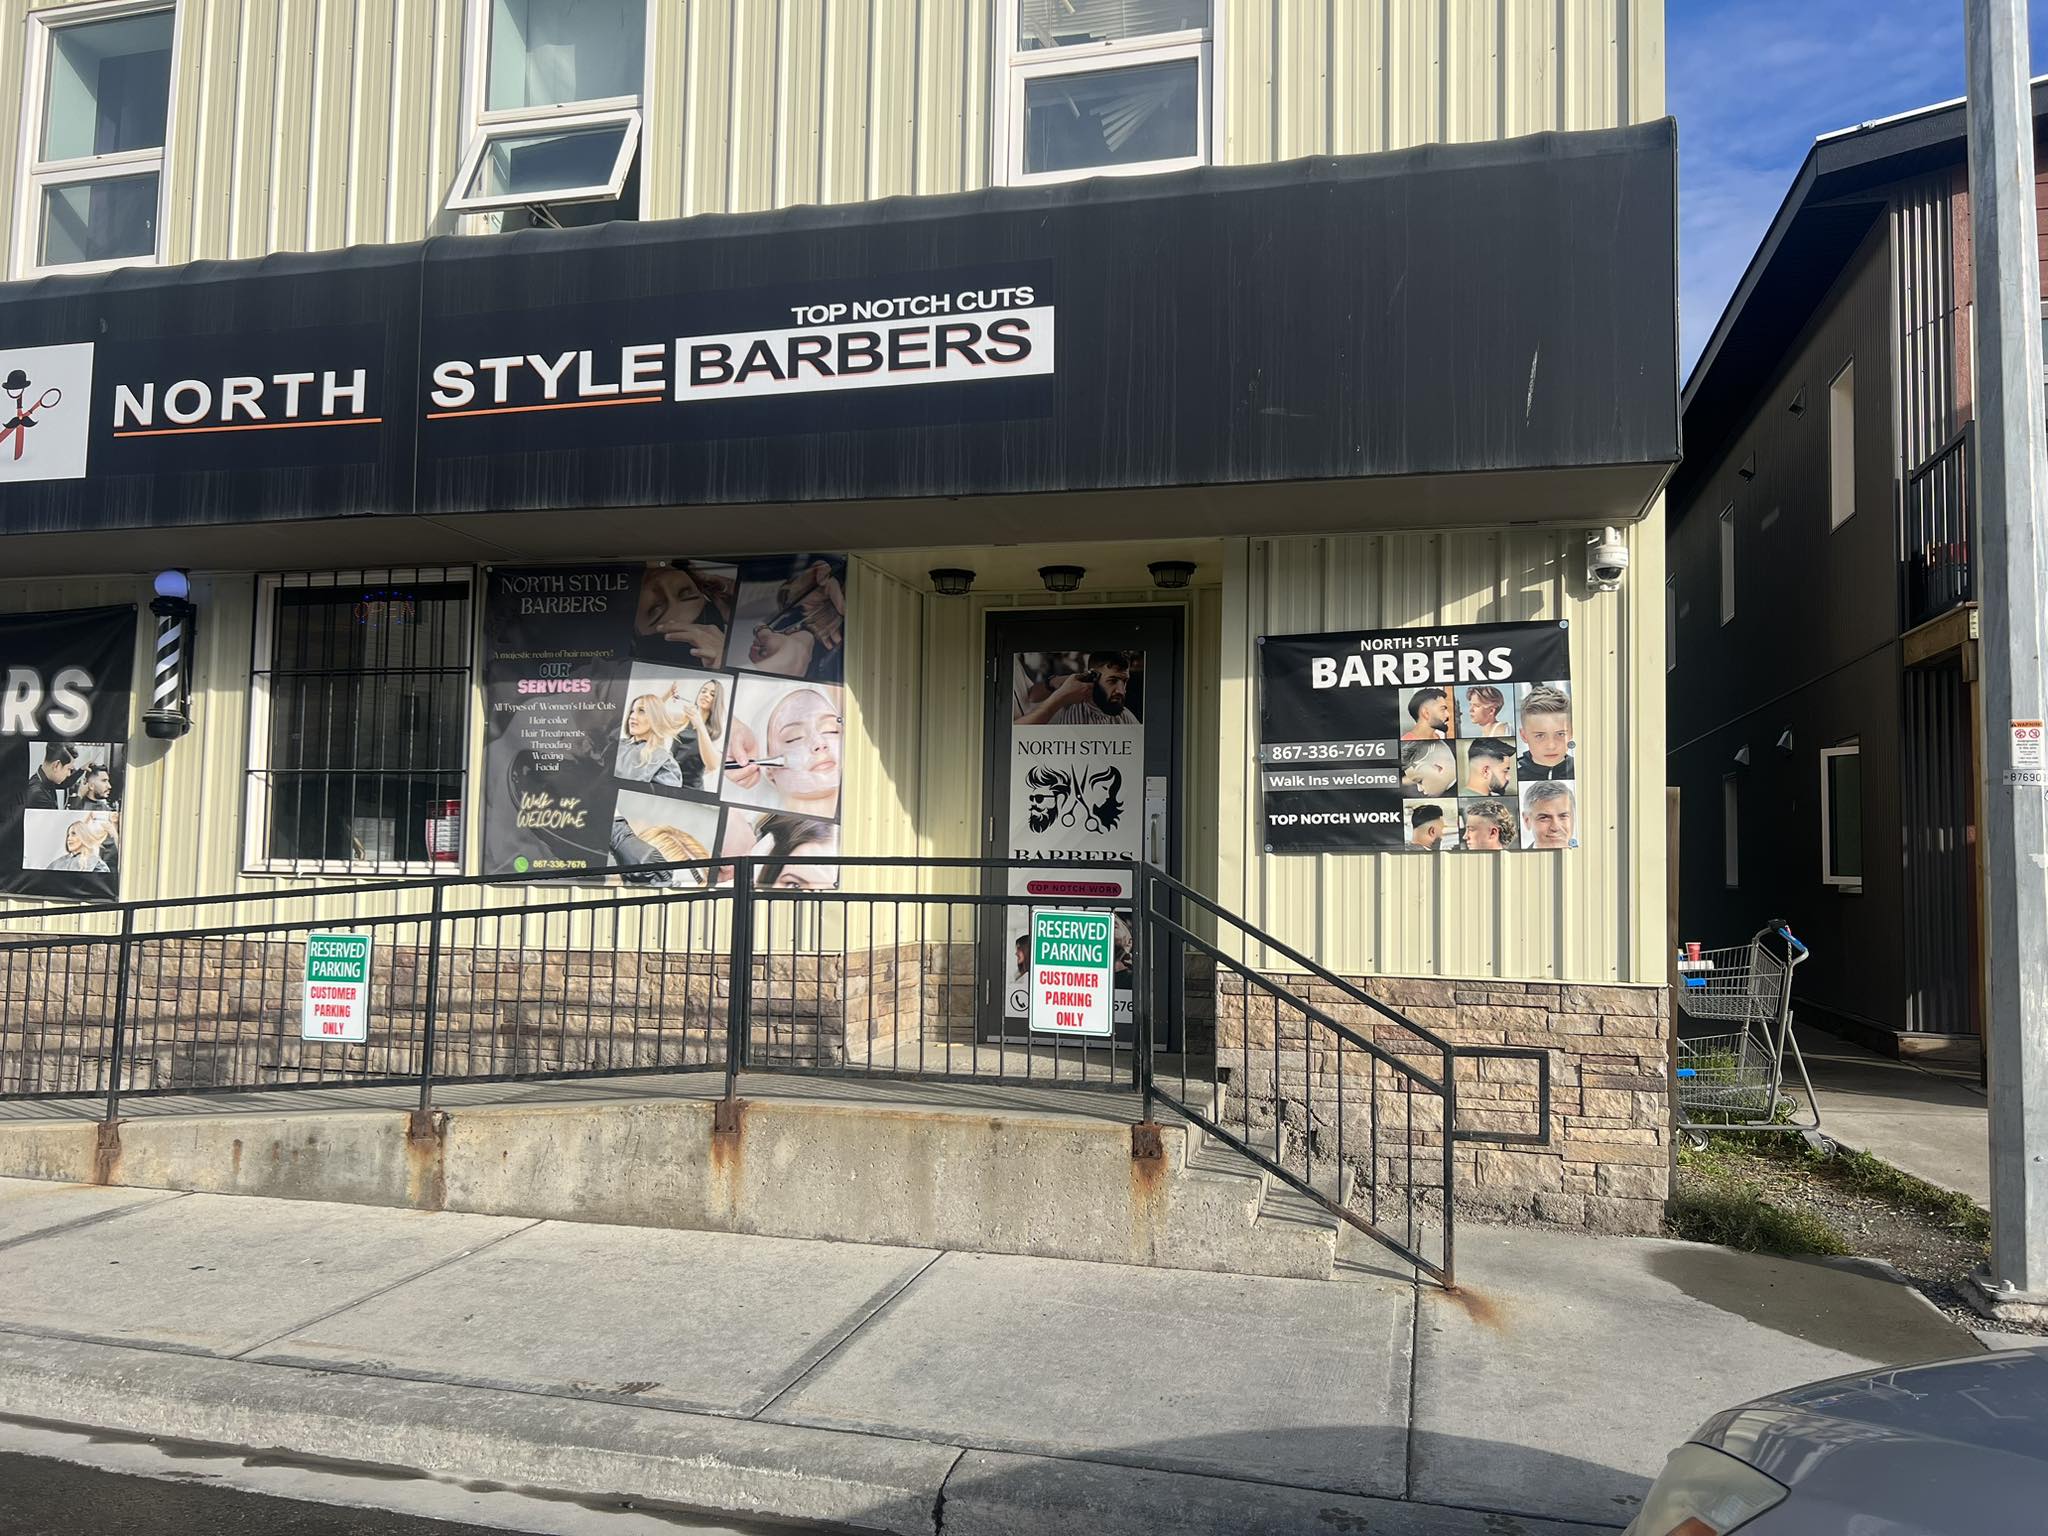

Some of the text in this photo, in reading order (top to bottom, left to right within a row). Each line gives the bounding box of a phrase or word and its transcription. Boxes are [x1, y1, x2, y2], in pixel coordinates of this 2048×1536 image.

[791, 286, 1036, 325] TOP NOTCH CUTS
[689, 318, 1034, 388] BARBERS
[113, 343, 666, 428] NORTH STYLE
[501, 573, 630, 594] NORTH STYLE
[520, 595, 608, 615] BARBERS
[1361, 634, 1459, 651] NORTH STYLE
[539, 662, 572, 678] OUR
[1312, 648, 1512, 689] BARBERS
[517, 679, 591, 694] SERVICES
[504, 702, 527, 713] Types
[528, 701, 538, 710] of
[539, 701, 578, 711] Women's
[579, 700, 596, 710] Hair
[597, 700, 616, 710] Cuts
[529, 715, 568, 725] Hair color
[521, 728, 585, 738] Hair Treatments
[531, 741, 572, 750] Threading
[1018, 740, 1132, 756] NORTH STYLE
[1272, 743, 1386, 760] 867-336-7676
[532, 751, 564, 762] Waxing
[535, 763, 559, 772] Facial
[1269, 773, 1398, 787] Walk Ins welcome
[521, 791, 553, 809] Walk
[516, 810, 588, 829] WELCOME
[1269, 811, 1401, 826] TOP NOTCH WORK
[1029, 881, 1118, 895] TOP NOTCH WORK
[1037, 920, 1107, 941] RESERVED
[310, 941, 365, 958] RESERVED
[1041, 942, 1103, 963] PARKING
[312, 961, 360, 977] PARKING
[1039, 970, 1099, 988] CUSTOMER
[311, 986, 356, 1000] CUSTOMER
[1045, 991, 1092, 1008] PARKING
[314, 1004, 351, 1018] PARKING
[1056, 1011, 1084, 1027] ONLY
[323, 1022, 344, 1035] ONLY
